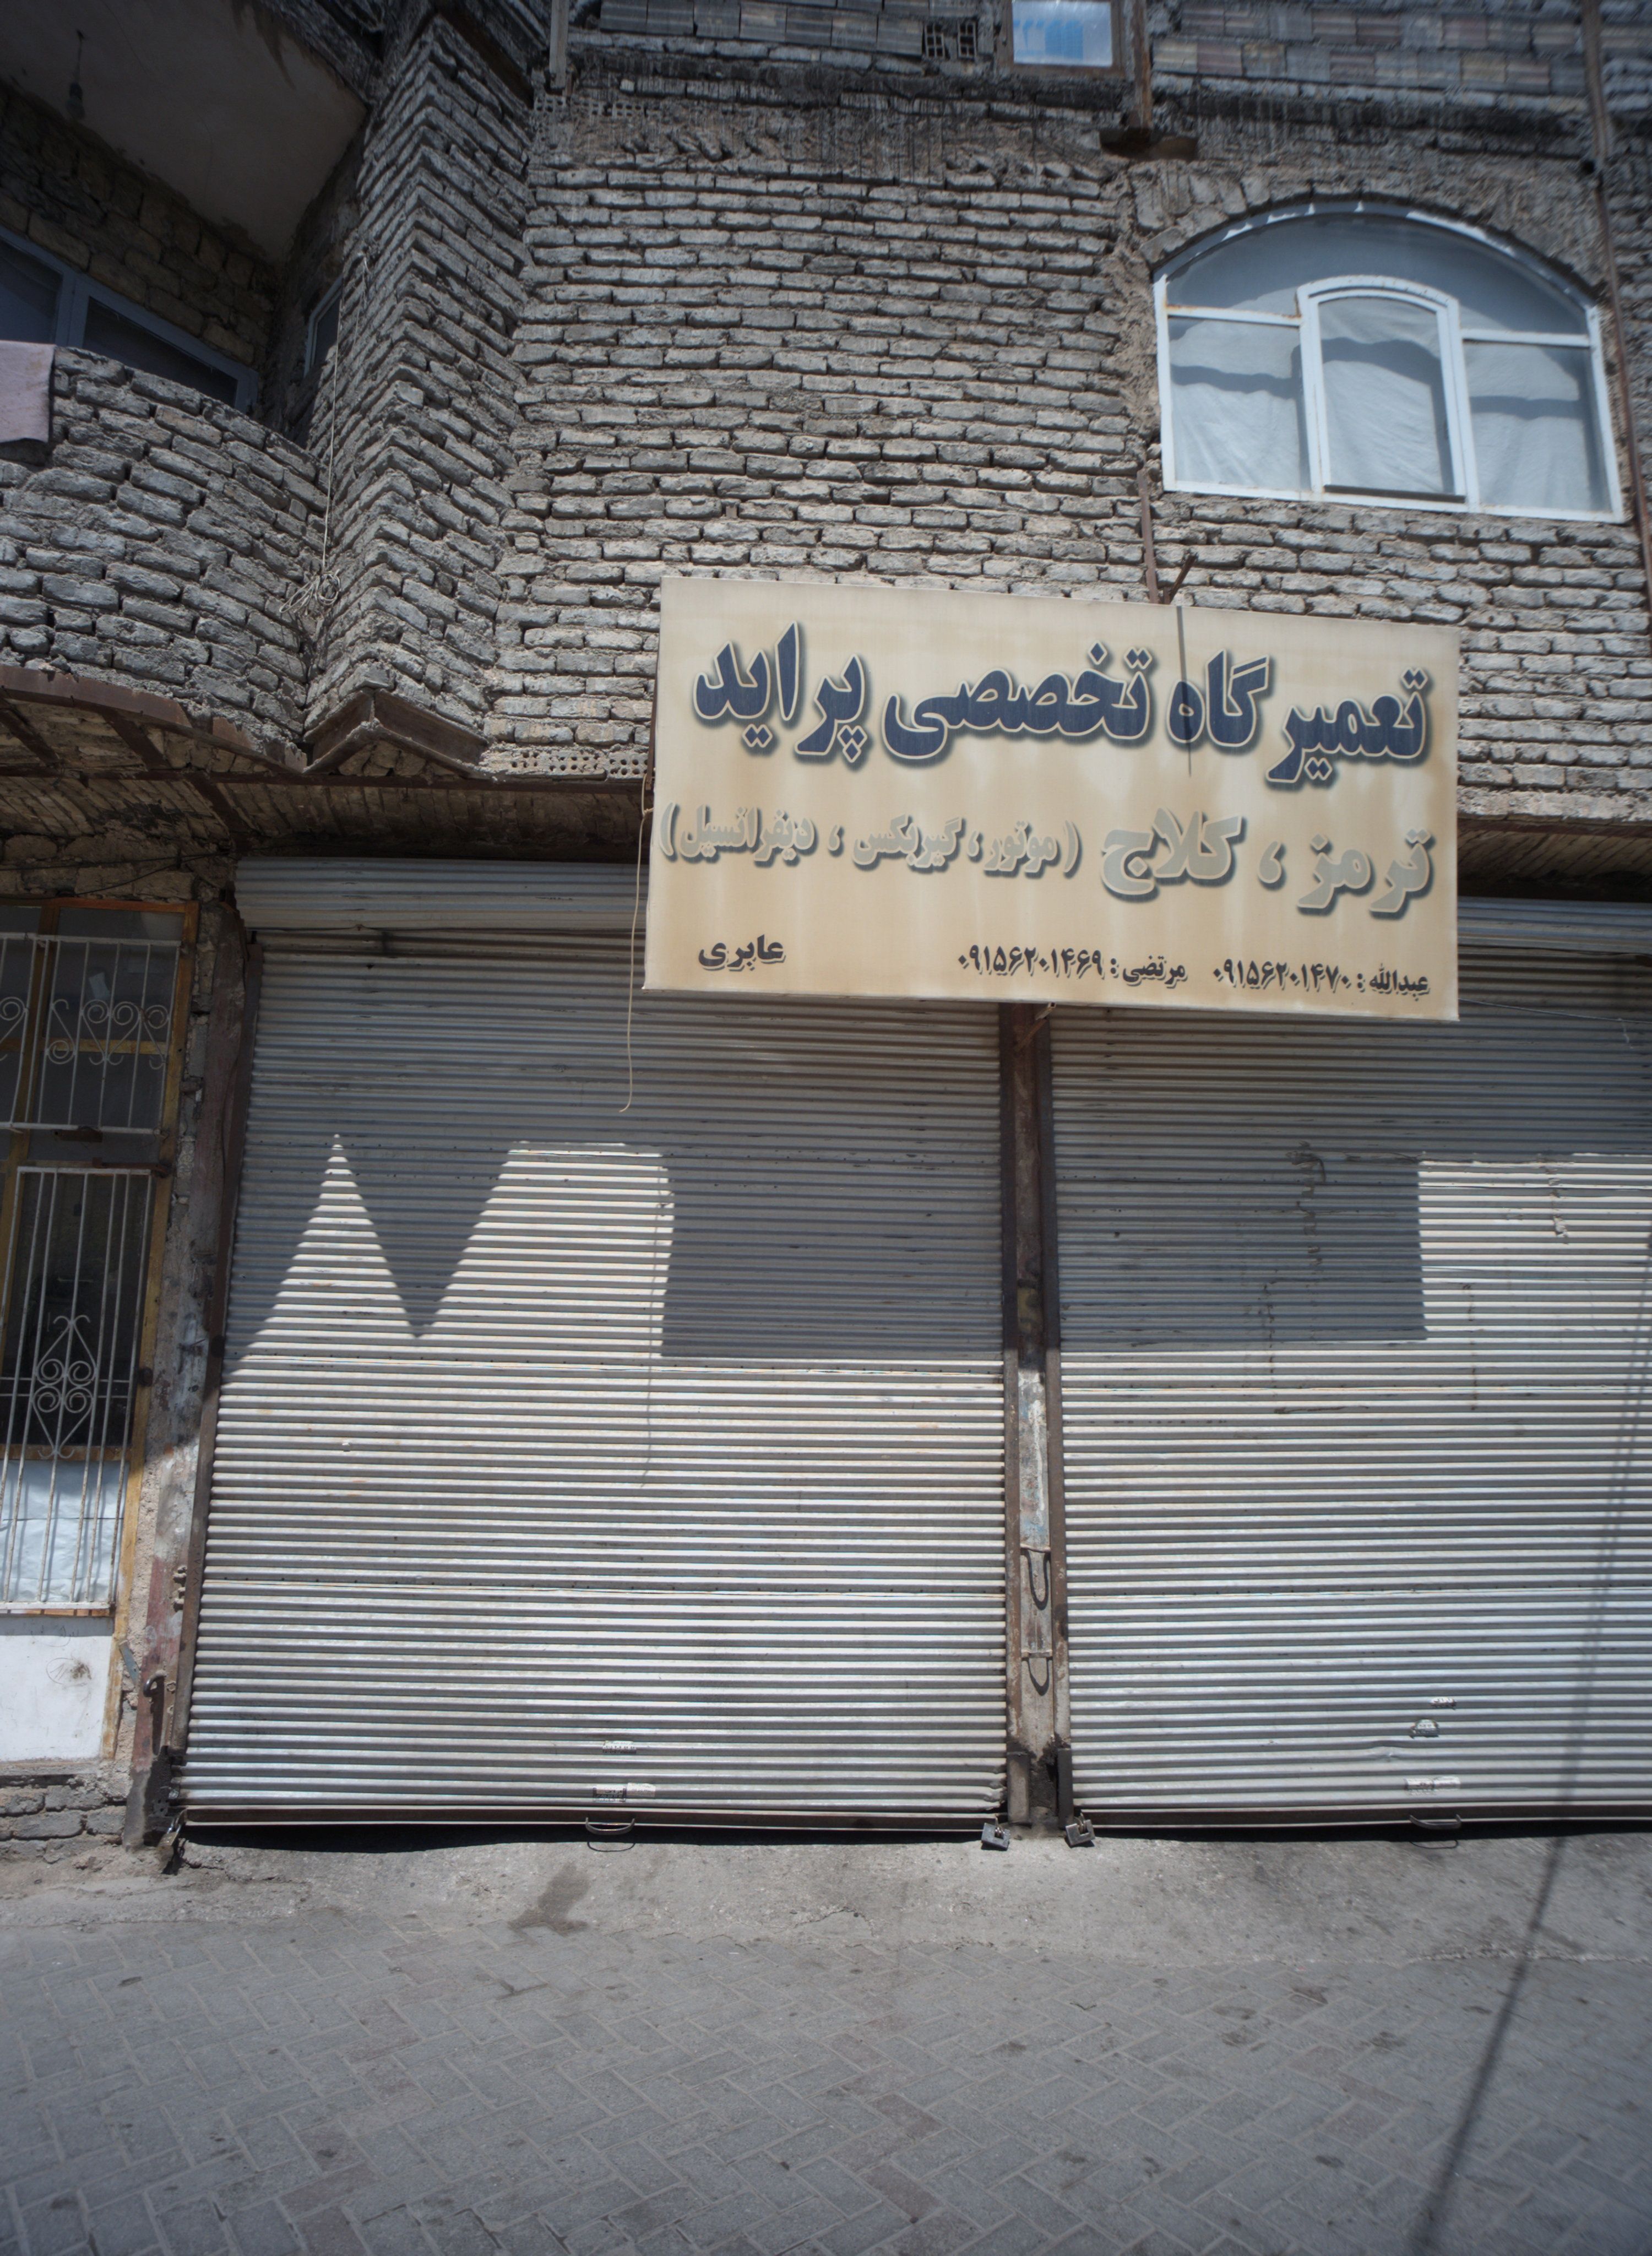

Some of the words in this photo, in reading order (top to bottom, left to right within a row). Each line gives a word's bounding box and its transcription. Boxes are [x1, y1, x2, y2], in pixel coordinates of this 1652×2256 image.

[692, 620, 868, 763] پراید
[882, 641, 1153, 760] تخصصی
[1167, 649, 1269, 747] گاه
[1267, 668, 1428, 782] تعمیر
[852, 813, 964, 869] گیربکس
[1102, 807, 1243, 896] کلاج
[698, 934, 786, 972] عابری
[958, 944, 1104, 979] ۰۹۱۵۶۲۰۱۴۶۹
[1213, 958, 1351, 993] ۰۹۱۵۶۲۰۱۴۷۰
